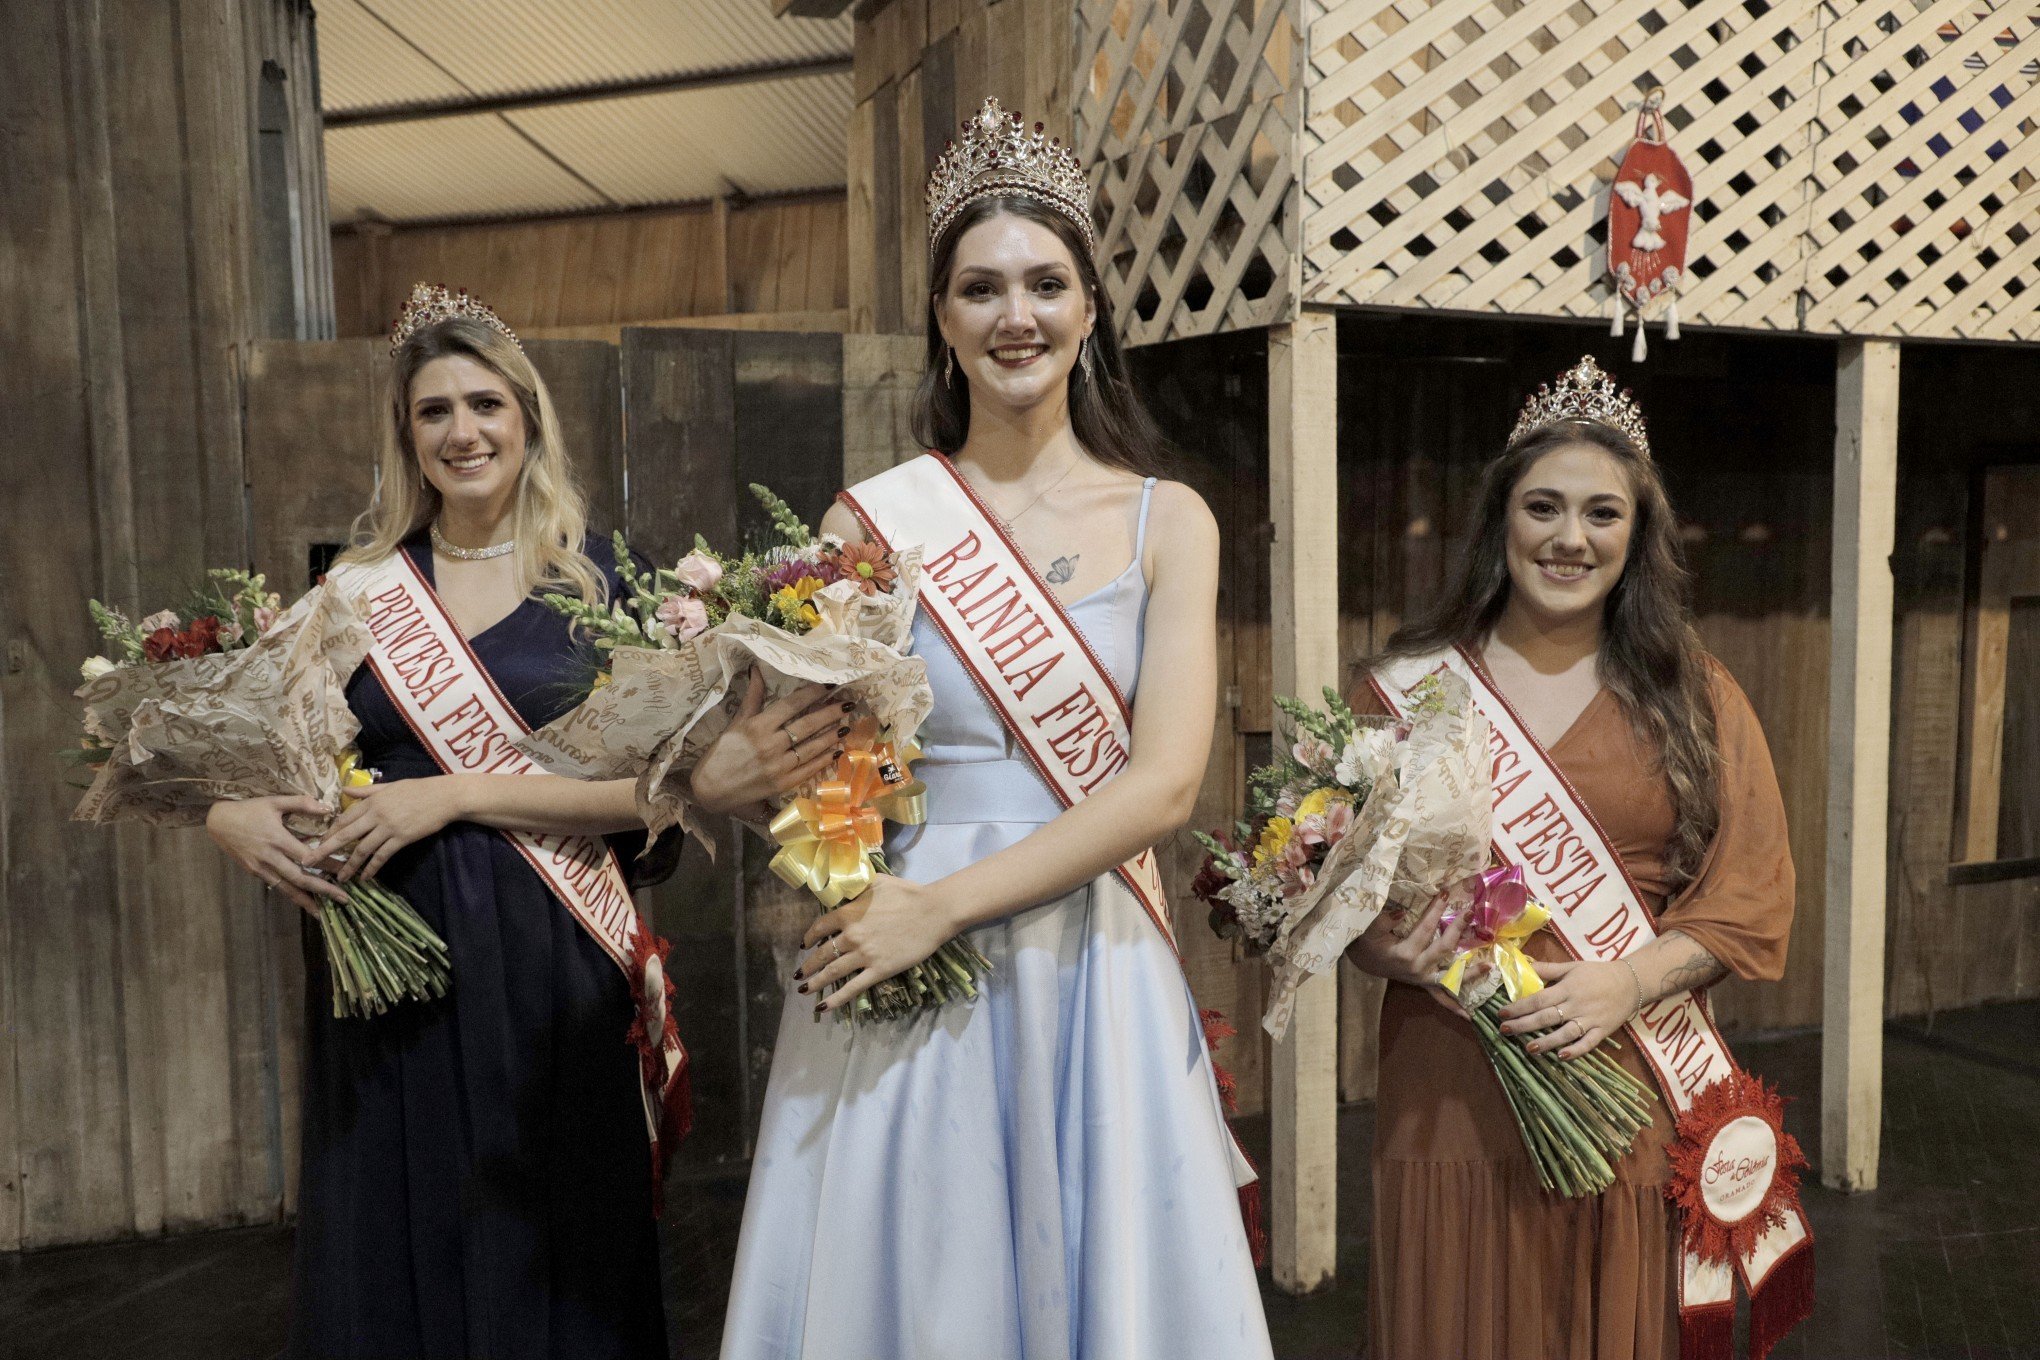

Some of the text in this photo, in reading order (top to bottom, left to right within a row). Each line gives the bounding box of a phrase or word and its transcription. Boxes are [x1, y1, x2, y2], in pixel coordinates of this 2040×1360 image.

[366, 583, 464, 711] PRINCESA
[922, 530, 1129, 797] RAINHA FEST
[1501, 793, 1639, 961] FESTA DA
[1640, 997, 1714, 1097] LÔNIA
[1720, 1180, 1755, 1201] GRAMADO
